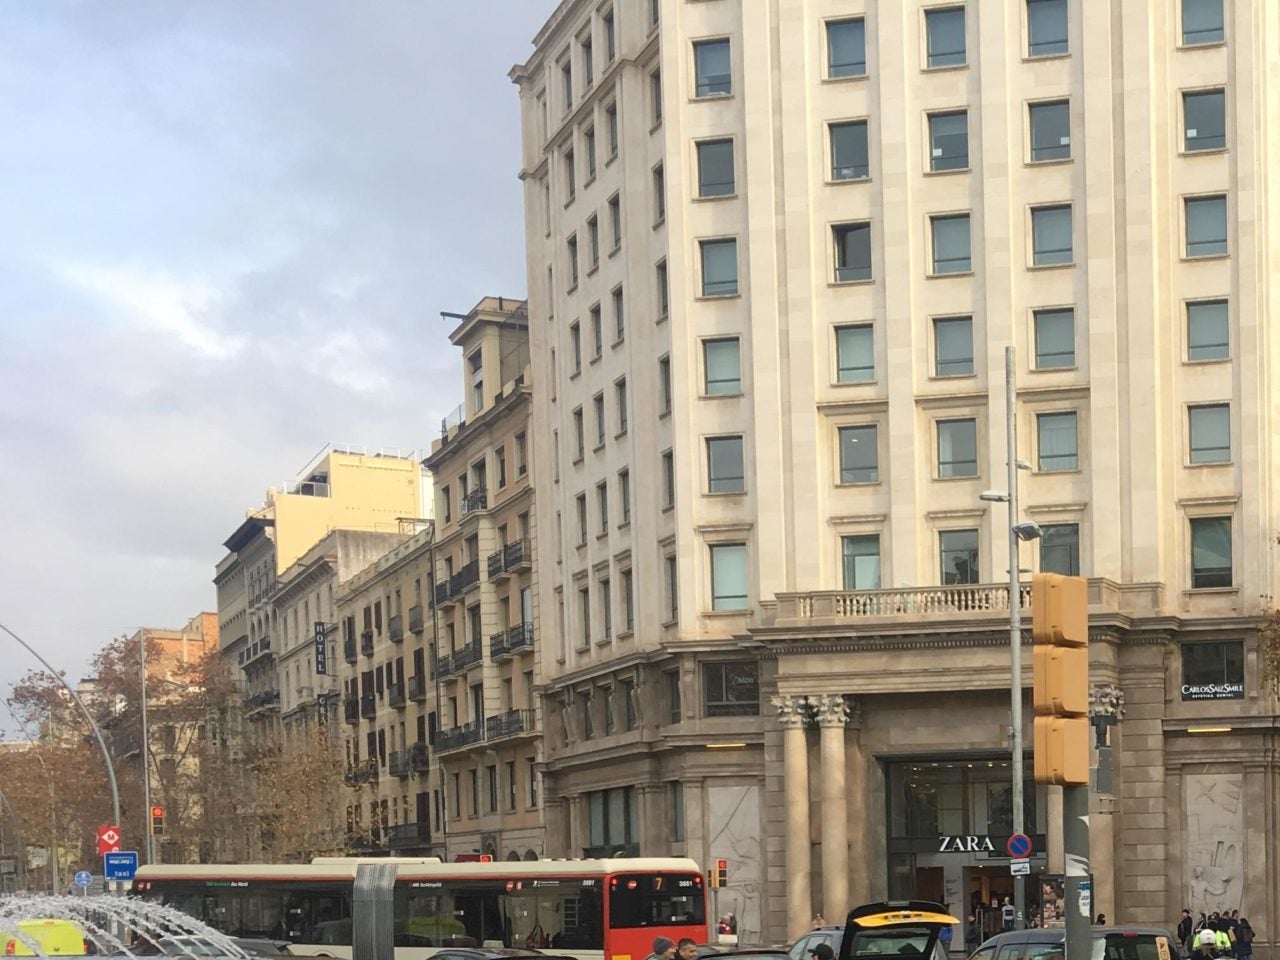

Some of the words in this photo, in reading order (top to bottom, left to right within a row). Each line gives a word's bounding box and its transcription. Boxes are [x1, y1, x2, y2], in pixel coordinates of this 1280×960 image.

[316, 625, 325, 672] HOTEL
[939, 836, 995, 852] ZARA
[655, 877, 663, 891] 7
